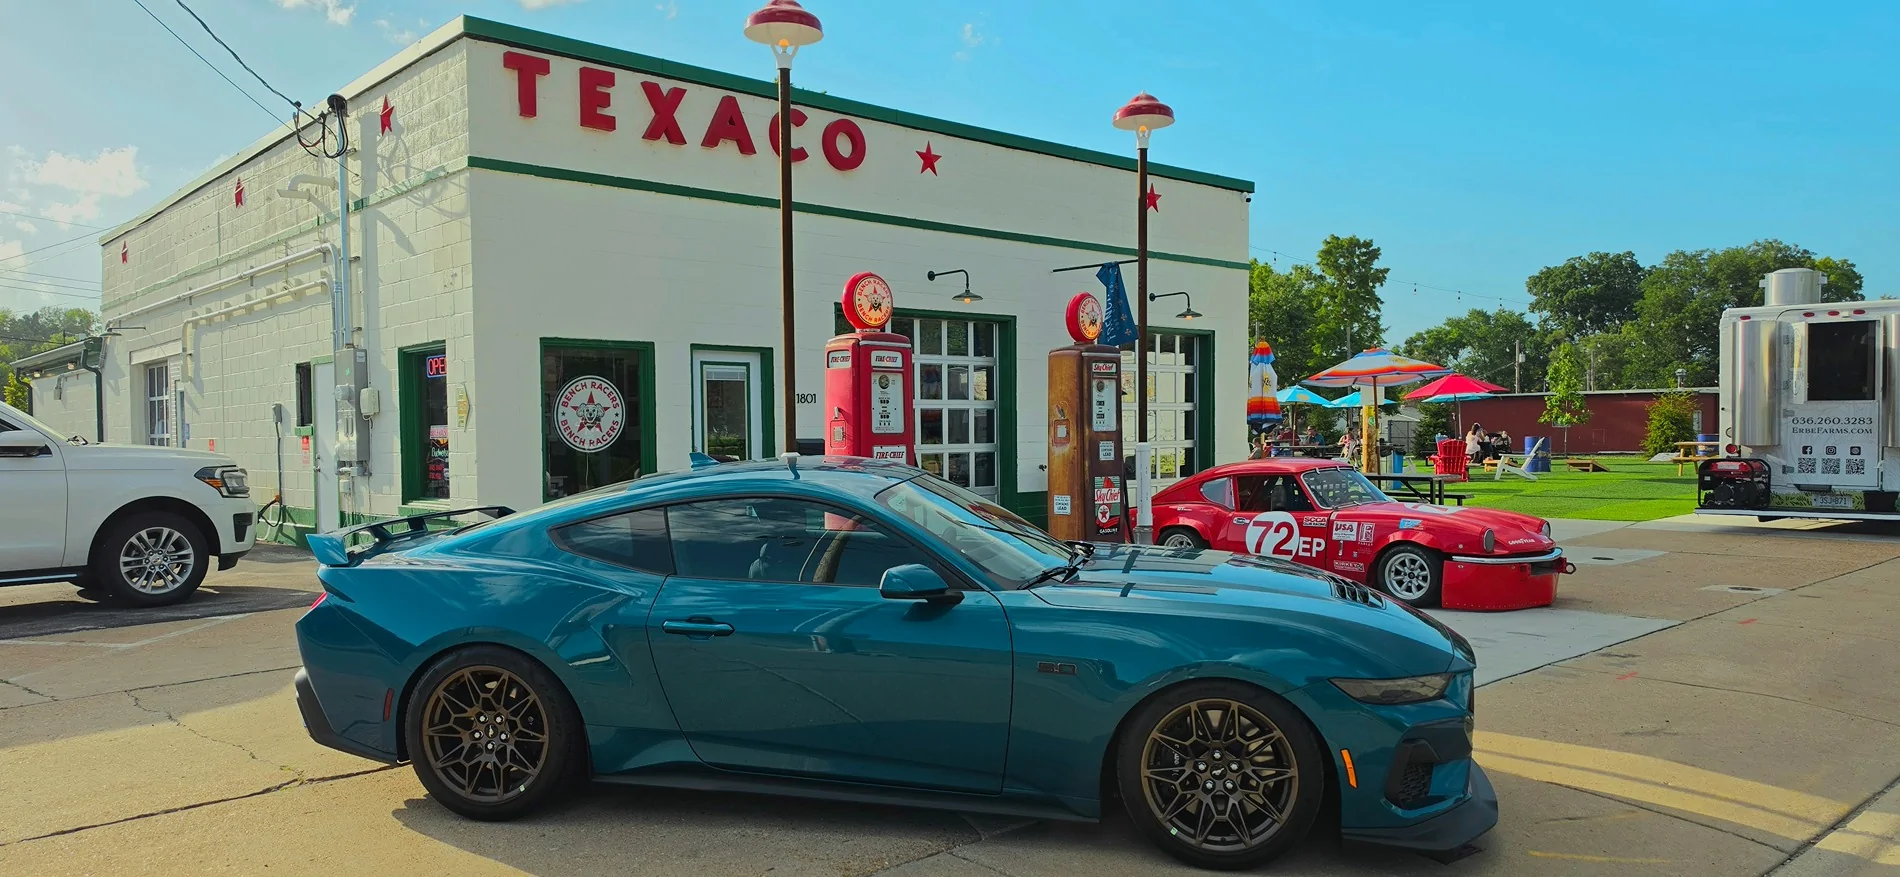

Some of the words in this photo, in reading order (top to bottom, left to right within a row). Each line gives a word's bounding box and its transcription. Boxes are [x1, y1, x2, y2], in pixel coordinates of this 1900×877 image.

[503, 50, 866, 171] TEXACO
[428, 358, 448, 375] OPE
[561, 381, 588, 408] BENCH
[590, 381, 620, 409] RACERS
[796, 393, 817, 404] 1801
[1791, 416, 1873, 425] 636.260.3283
[560, 419, 586, 446] BENCH
[589, 420, 620, 447] RACERS
[876, 451, 905, 460] FIRE-CHIEF
[1335, 523, 1354, 532] USA
[1252, 520, 1295, 556] 72
[1298, 536, 1326, 557] EP
